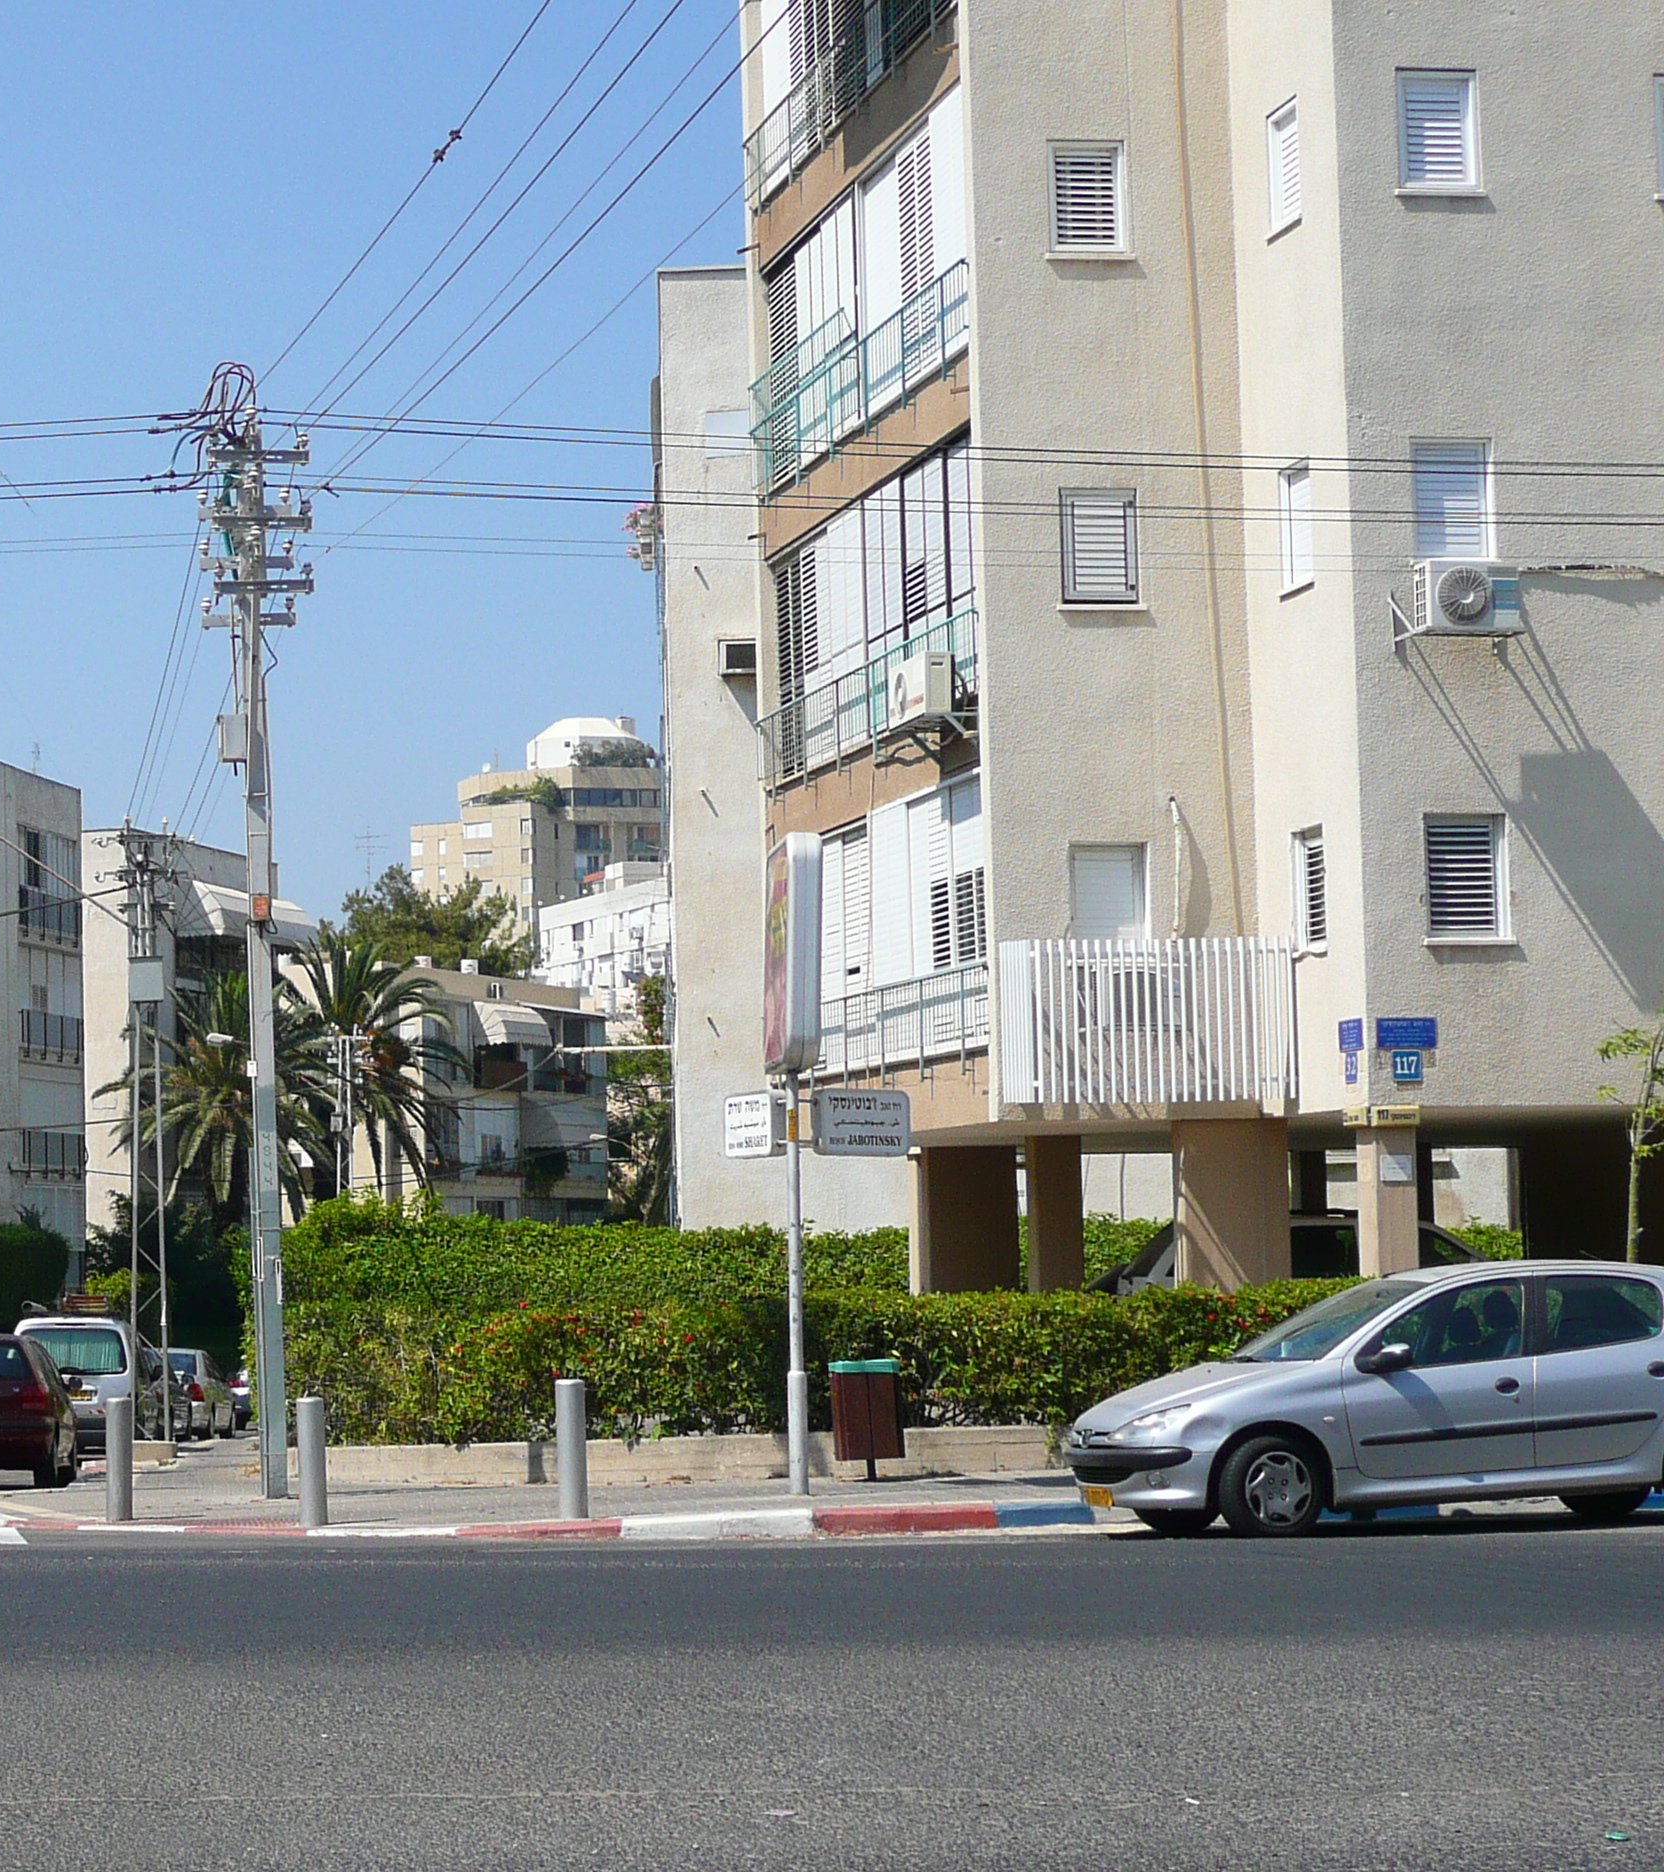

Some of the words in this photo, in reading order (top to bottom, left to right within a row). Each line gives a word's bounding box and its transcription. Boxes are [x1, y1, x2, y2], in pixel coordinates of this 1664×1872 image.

[1395, 1056, 1417, 1074] 117
[1377, 1109, 1390, 1120] 117
[847, 1134, 903, 1147] JABOTINSKY
